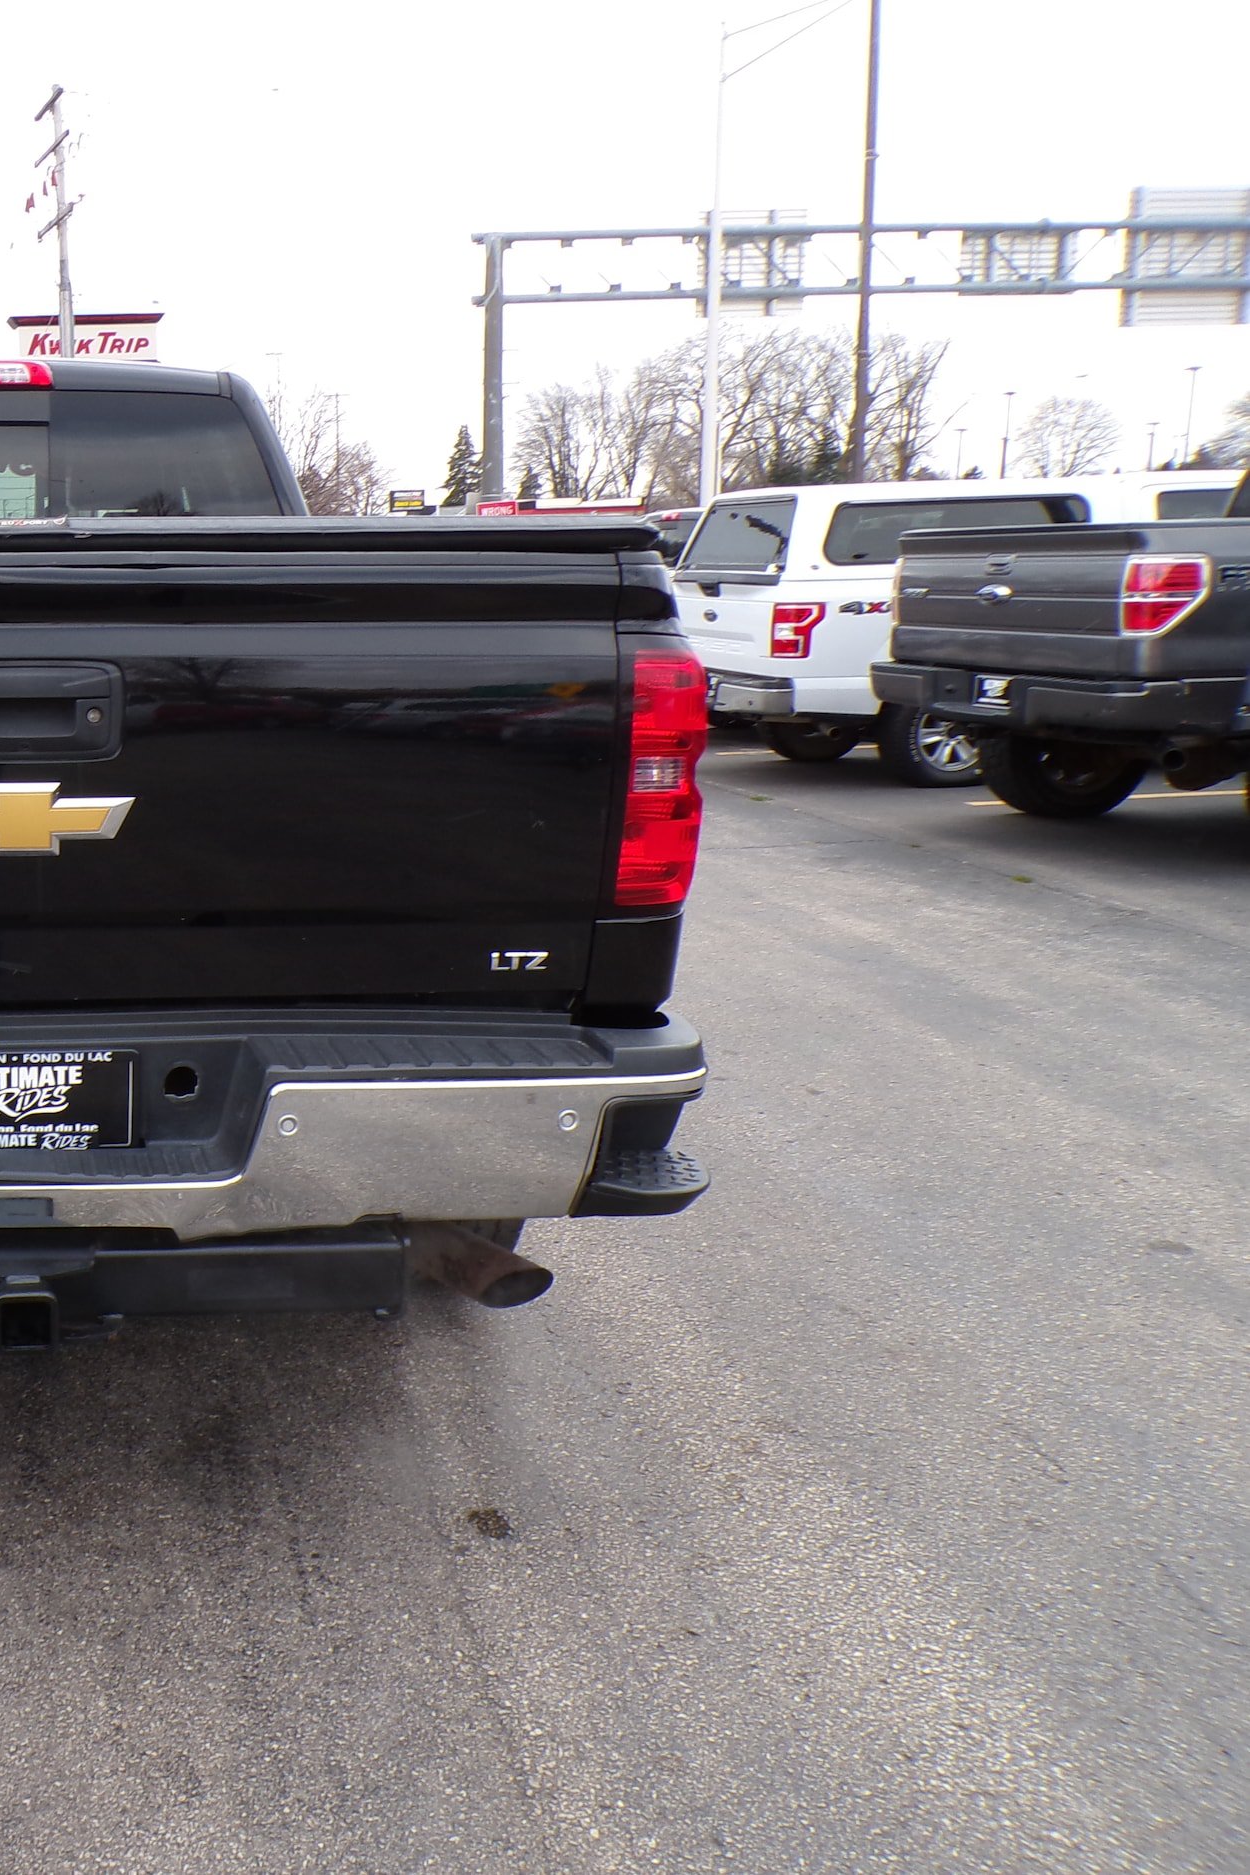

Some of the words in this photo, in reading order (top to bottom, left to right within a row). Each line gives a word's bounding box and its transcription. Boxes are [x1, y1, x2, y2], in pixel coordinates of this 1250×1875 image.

[28, 333, 95, 355] KWK
[98, 332, 150, 354] TRIP
[490, 951, 549, 971] LTZ
[22, 1052, 62, 1063] FOND
[64, 1051, 85, 1063] DU
[87, 1051, 113, 1062] LAC
[39, 1131, 93, 1151] RIDES
